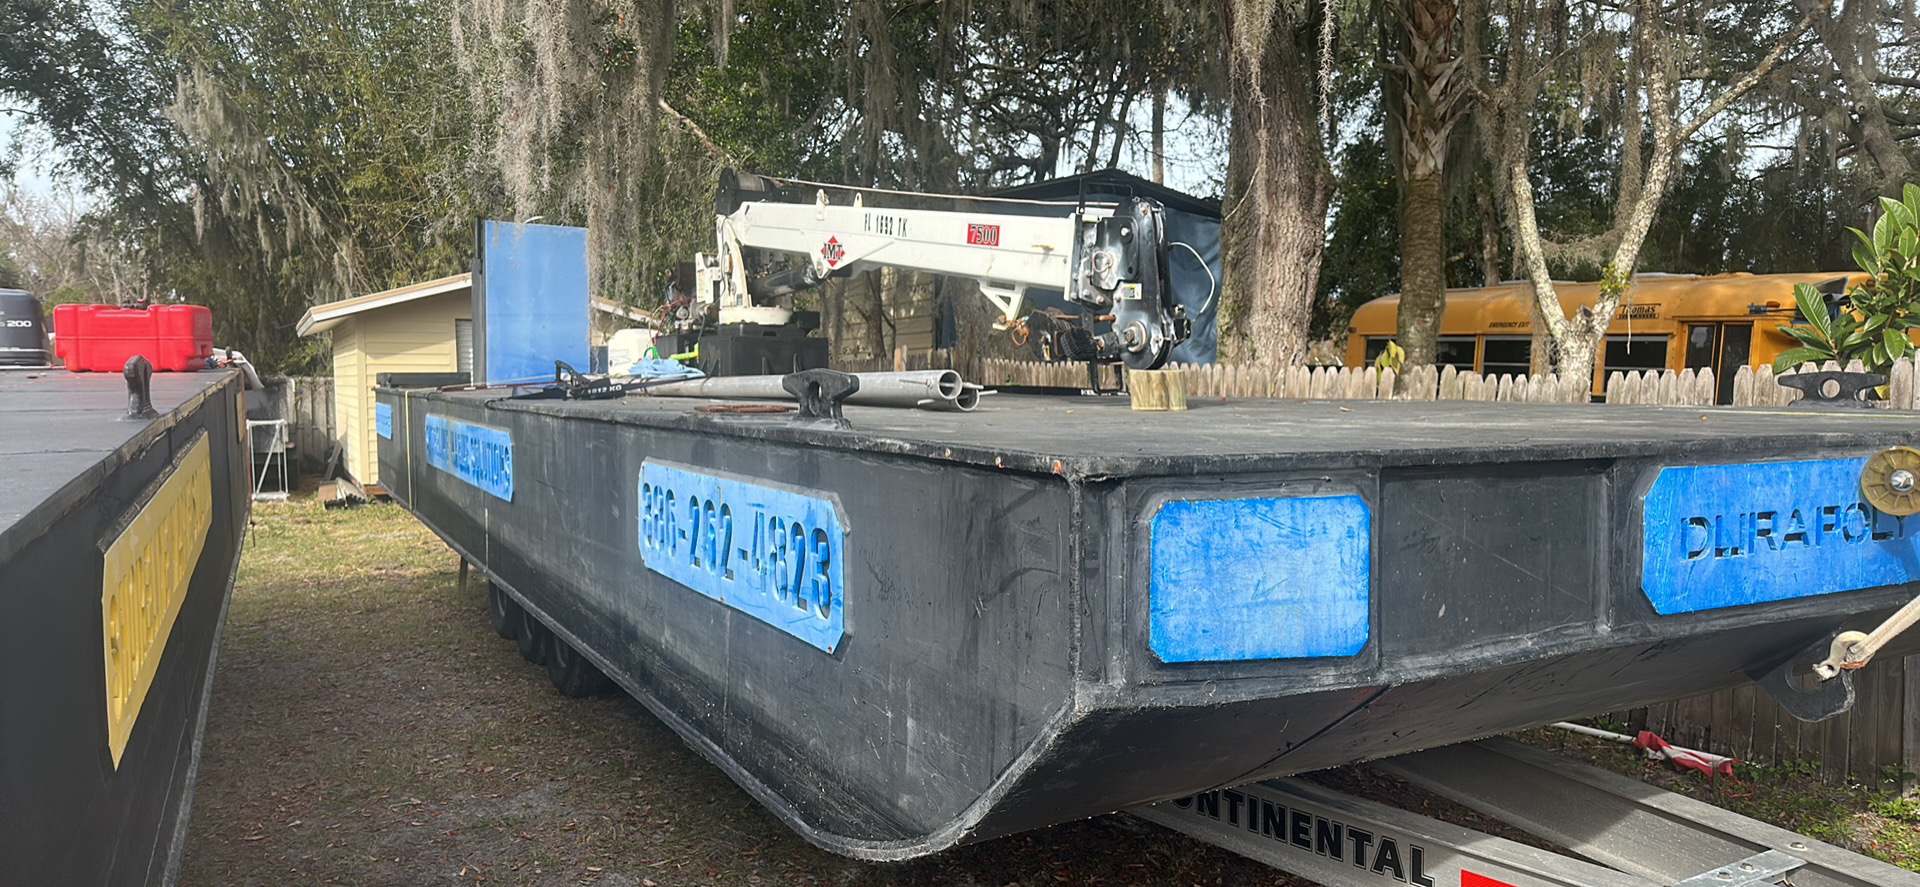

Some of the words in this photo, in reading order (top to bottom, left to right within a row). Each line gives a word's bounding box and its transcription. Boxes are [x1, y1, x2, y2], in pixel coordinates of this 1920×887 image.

[969, 225, 998, 246] 7500
[823, 243, 843, 260] IMT
[6, 320, 32, 328] 200
